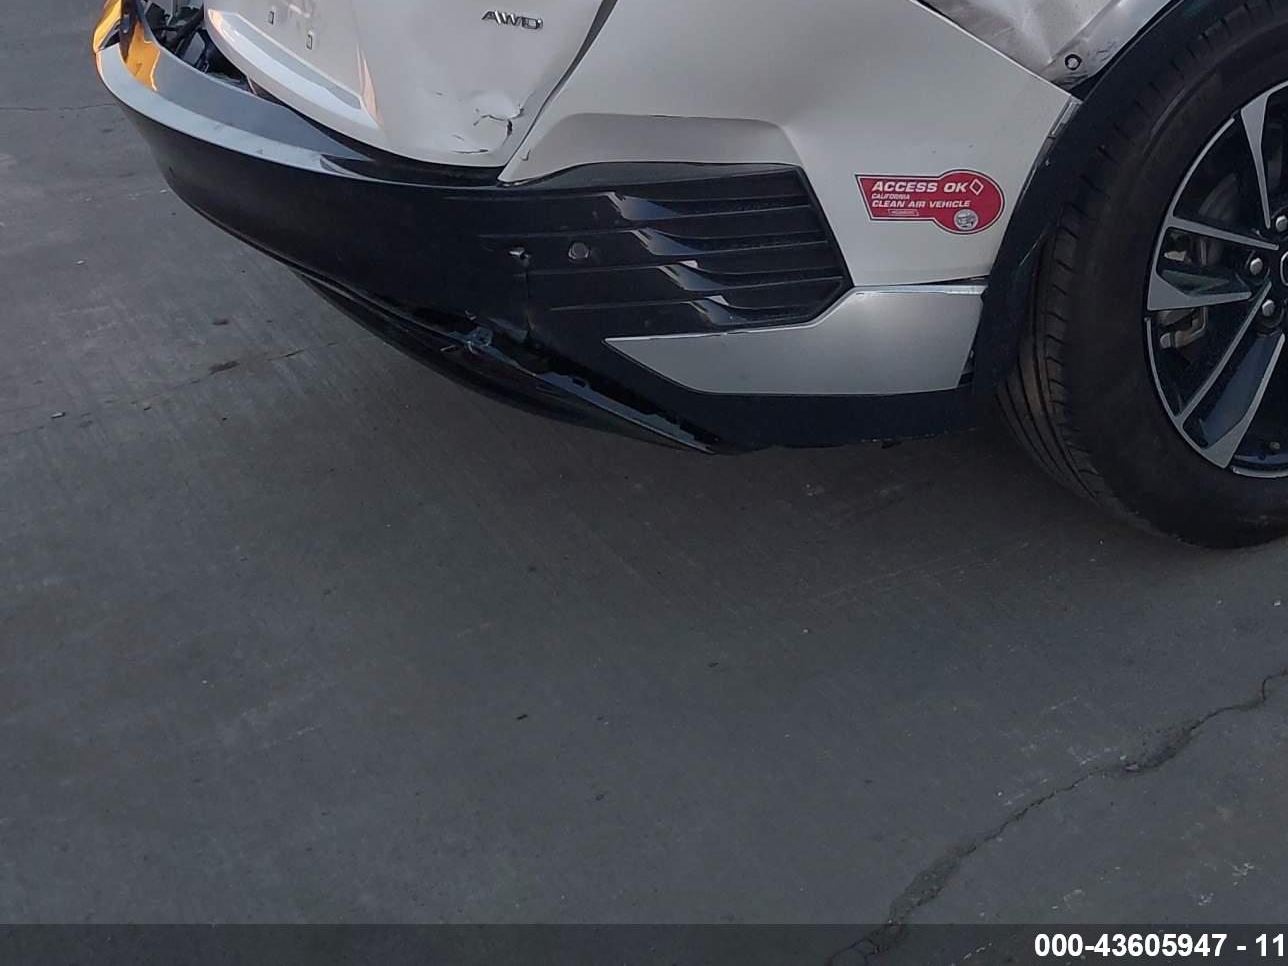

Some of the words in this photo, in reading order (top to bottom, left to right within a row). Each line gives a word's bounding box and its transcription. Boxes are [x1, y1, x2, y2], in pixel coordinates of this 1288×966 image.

[481, 10, 543, 30] AWD
[872, 181, 937, 193] ACCESS
[943, 182, 968, 193] OK
[872, 200, 906, 208] CLEAN
[907, 200, 926, 208] AIR
[930, 200, 971, 208] VEHICLE
